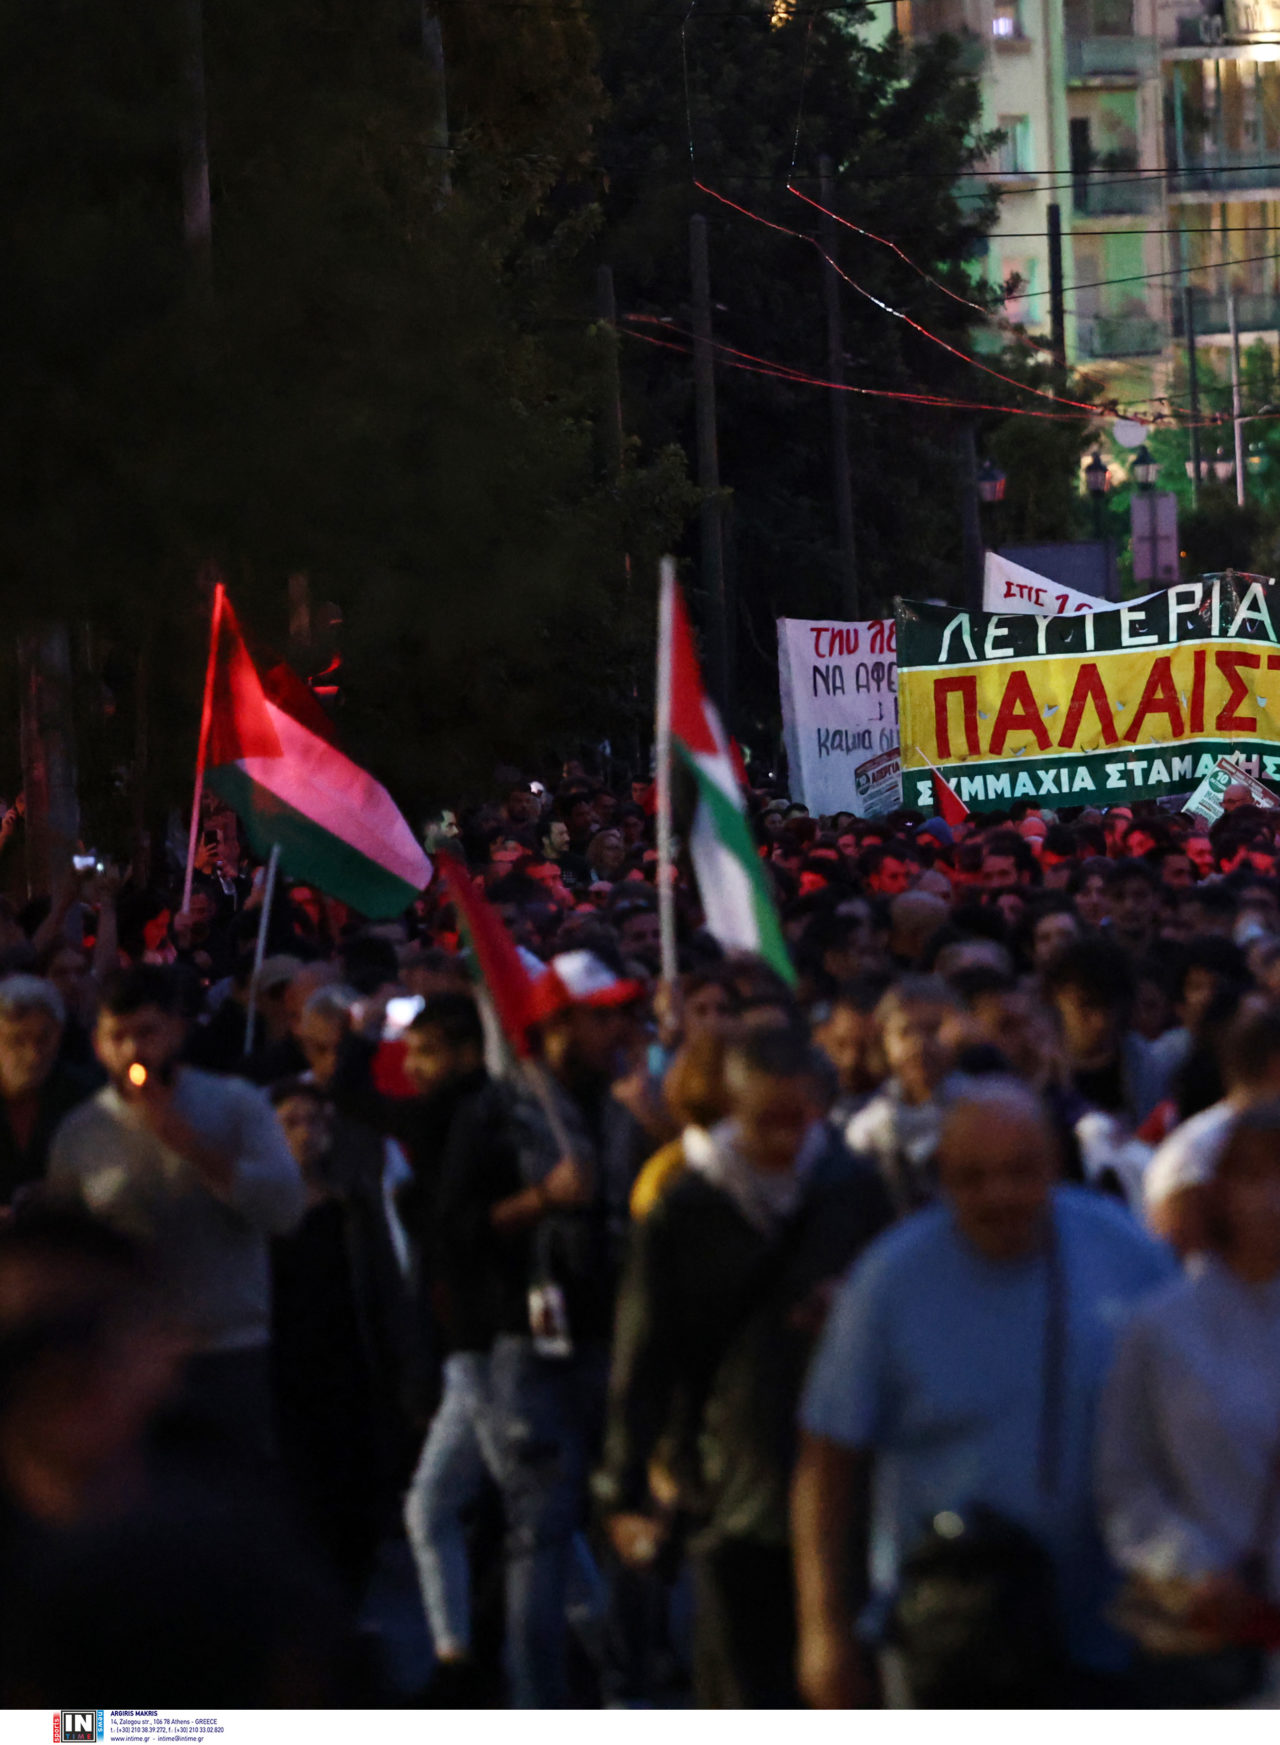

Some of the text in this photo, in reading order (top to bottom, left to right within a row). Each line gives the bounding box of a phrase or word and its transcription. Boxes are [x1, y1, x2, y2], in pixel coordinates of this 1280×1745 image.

[1003, 581, 1047, 607] ΣΤΙΣ
[938, 580, 1278, 663] ΛΕΥΤΕΡΙΑ
[812, 665, 845, 697] ΝΑ
